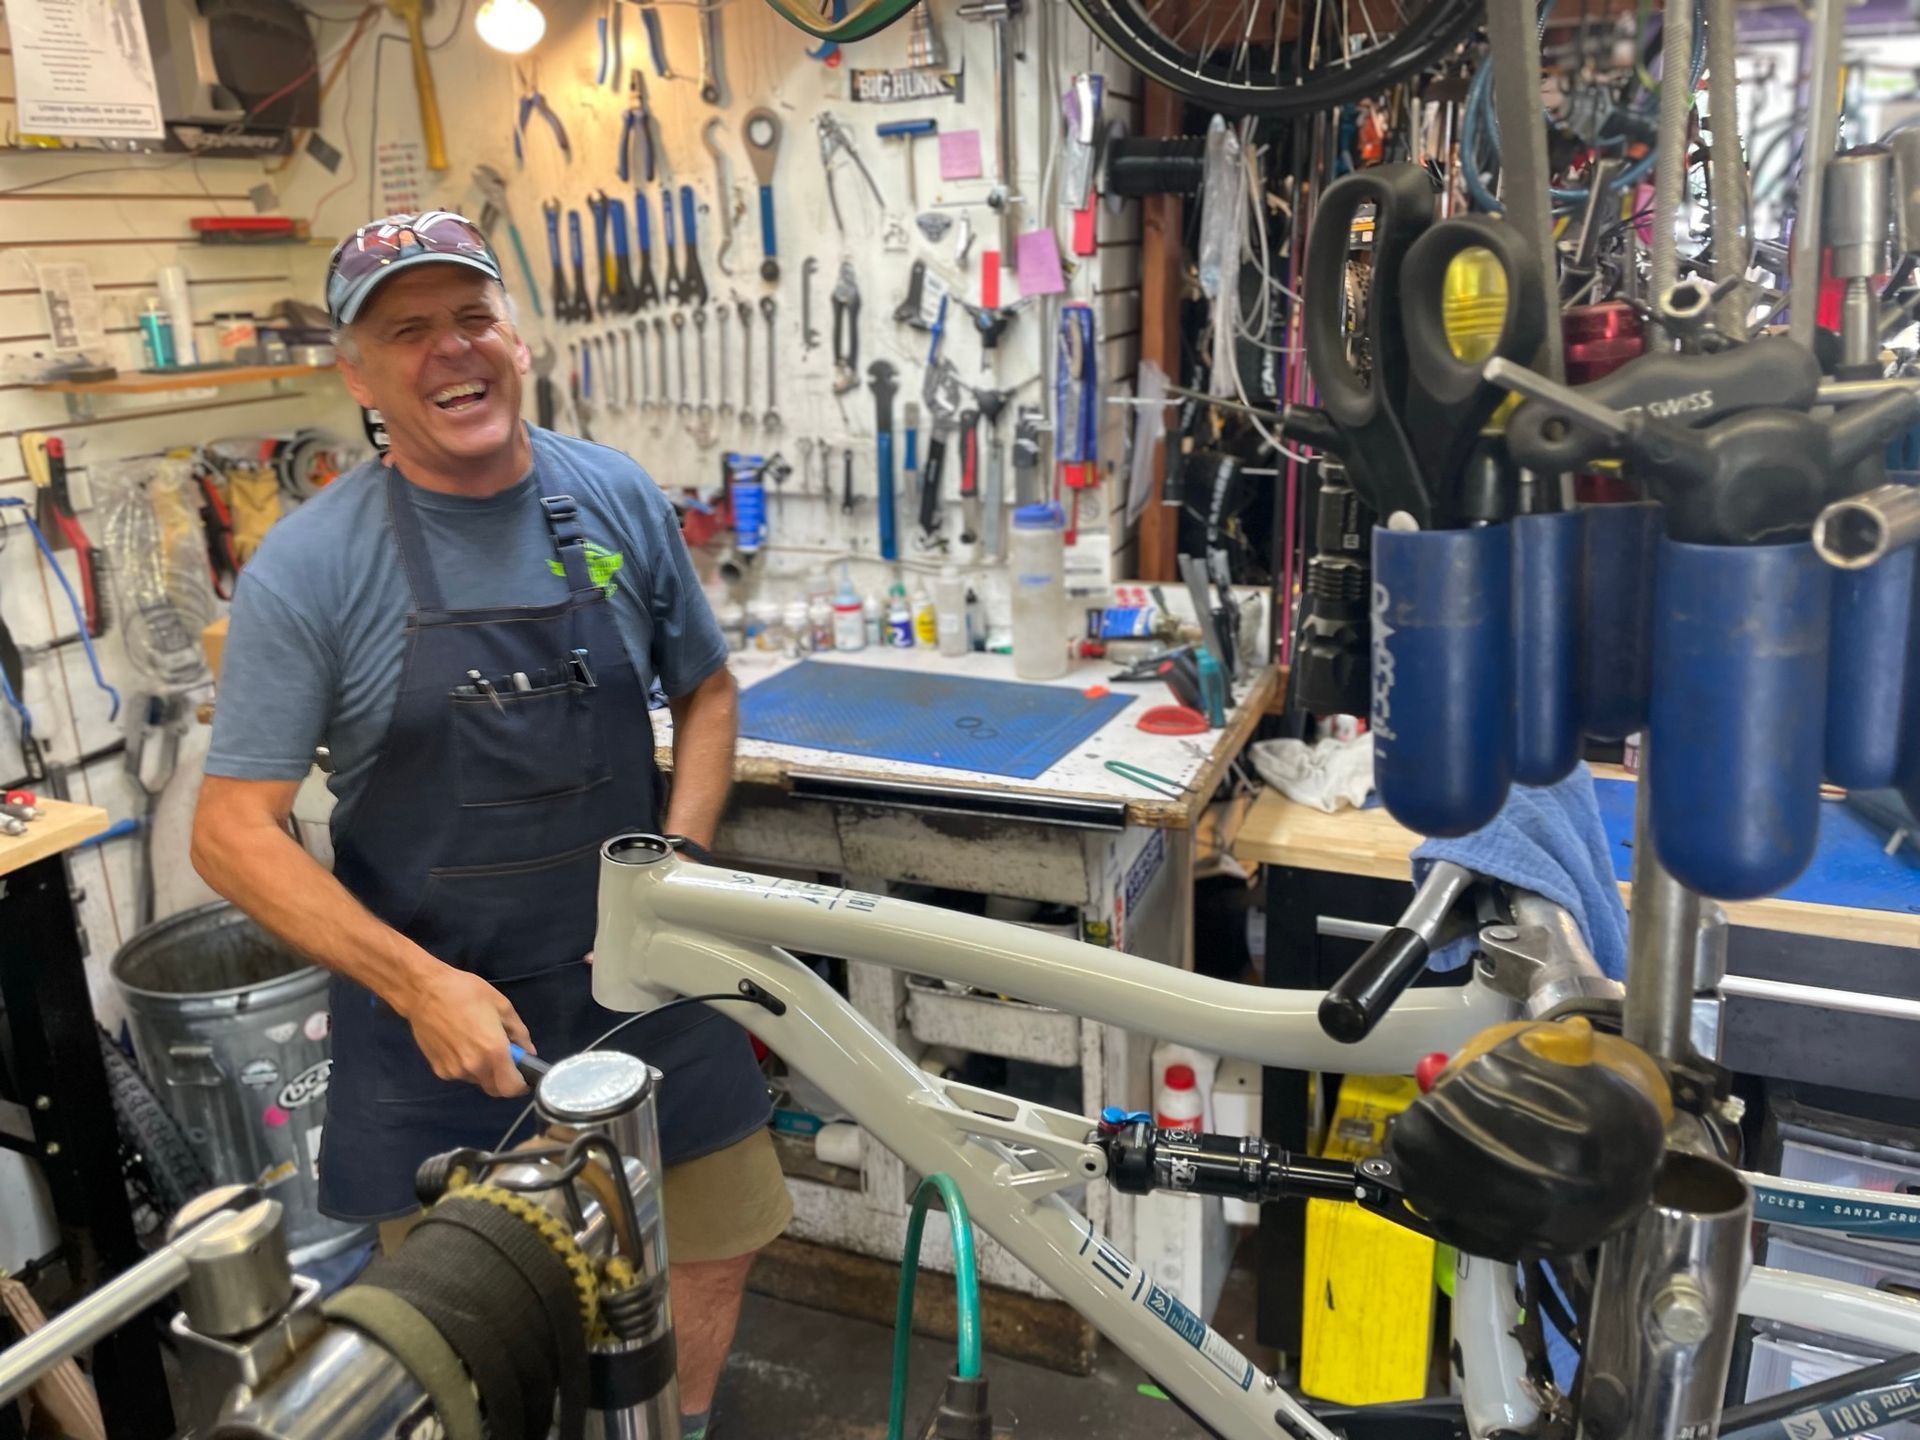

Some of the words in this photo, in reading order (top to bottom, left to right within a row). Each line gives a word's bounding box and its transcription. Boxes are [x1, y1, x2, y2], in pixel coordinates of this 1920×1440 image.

[1647, 390, 1714, 418] SWISS
[1758, 1193, 1806, 1210] YCLES
[1833, 1205, 1882, 1219] SANTA
[1888, 1211, 1920, 1224] CRU
[1831, 1400, 1878, 1432] IBIS
